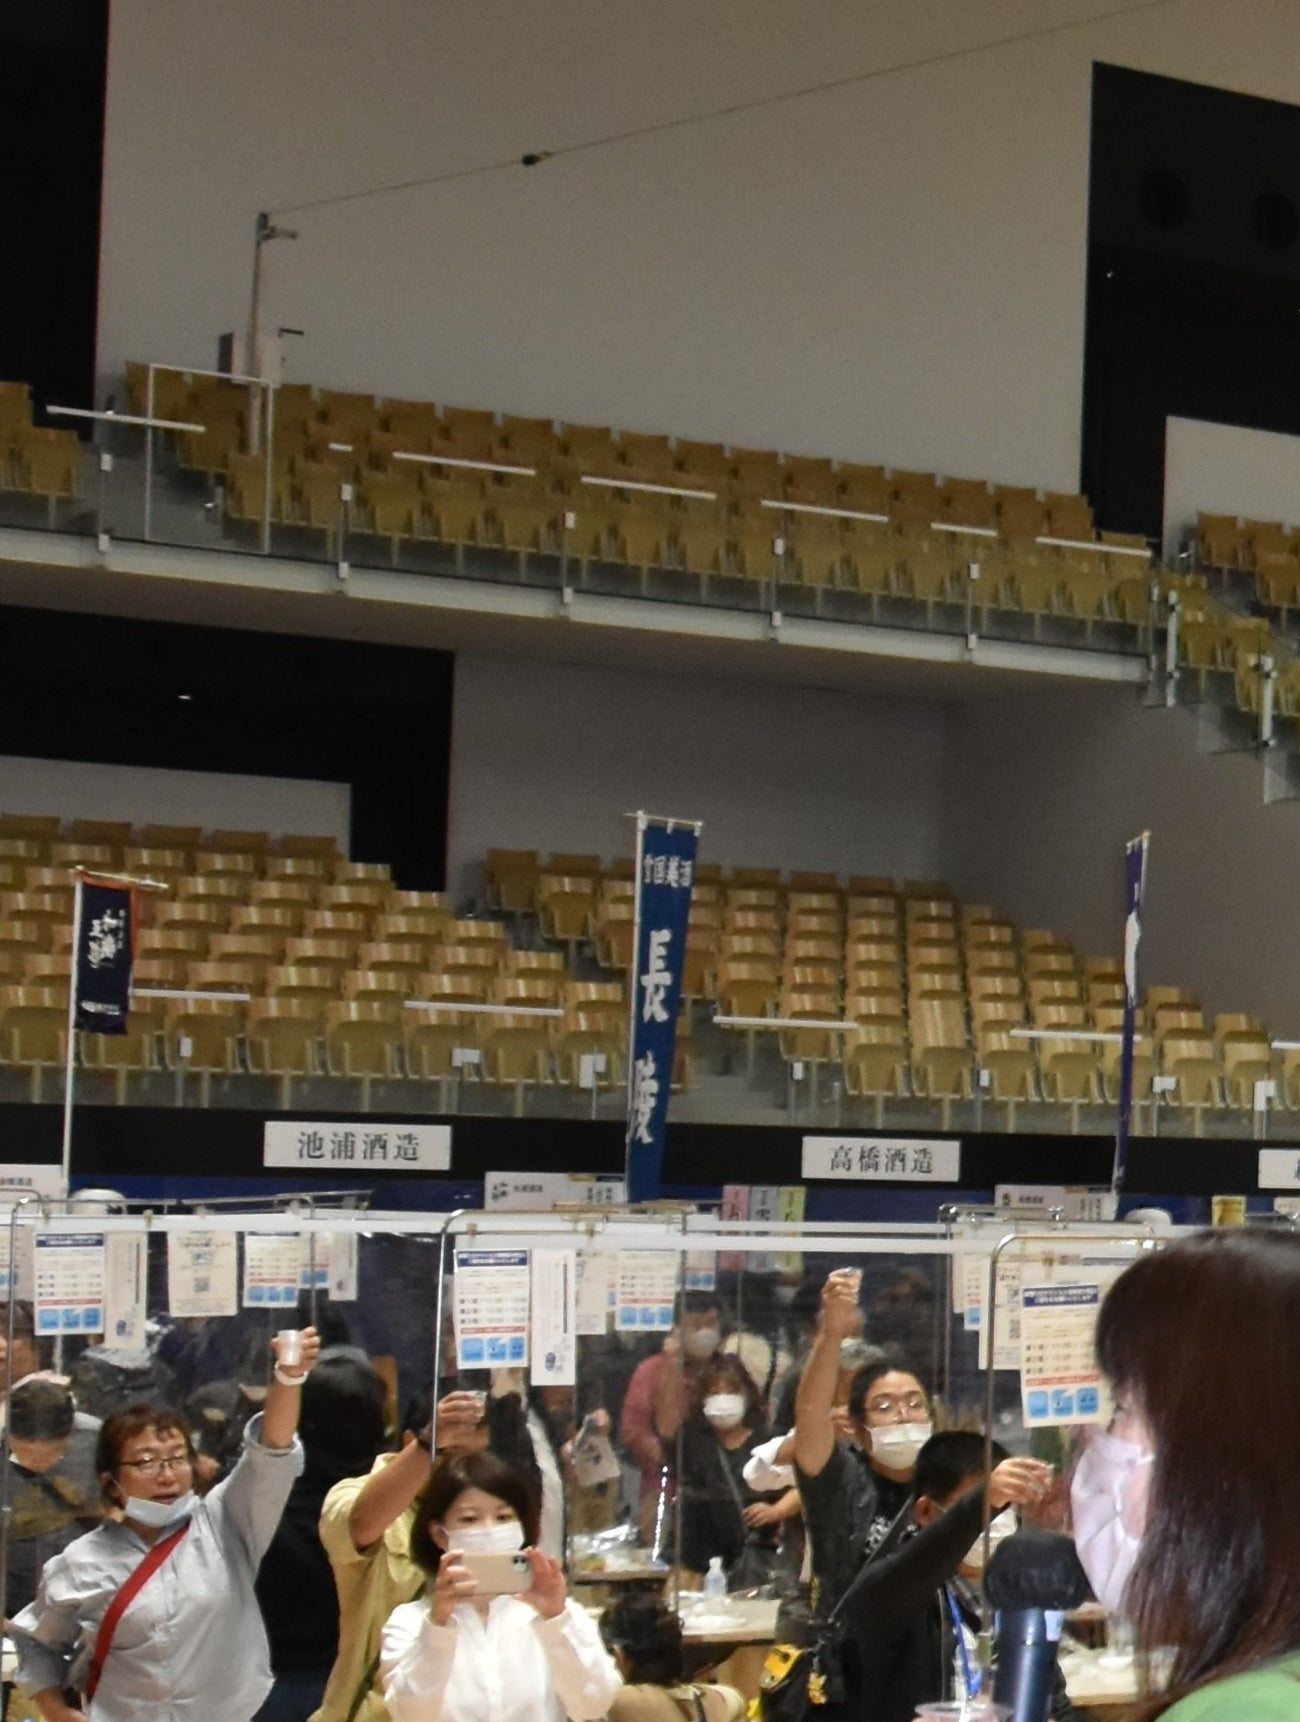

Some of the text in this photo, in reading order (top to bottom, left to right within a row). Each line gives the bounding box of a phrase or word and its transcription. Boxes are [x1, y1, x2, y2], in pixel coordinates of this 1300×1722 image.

[297, 1131, 420, 1162] 池浦酒造
[829, 1145, 934, 1175] 高橋酒造
